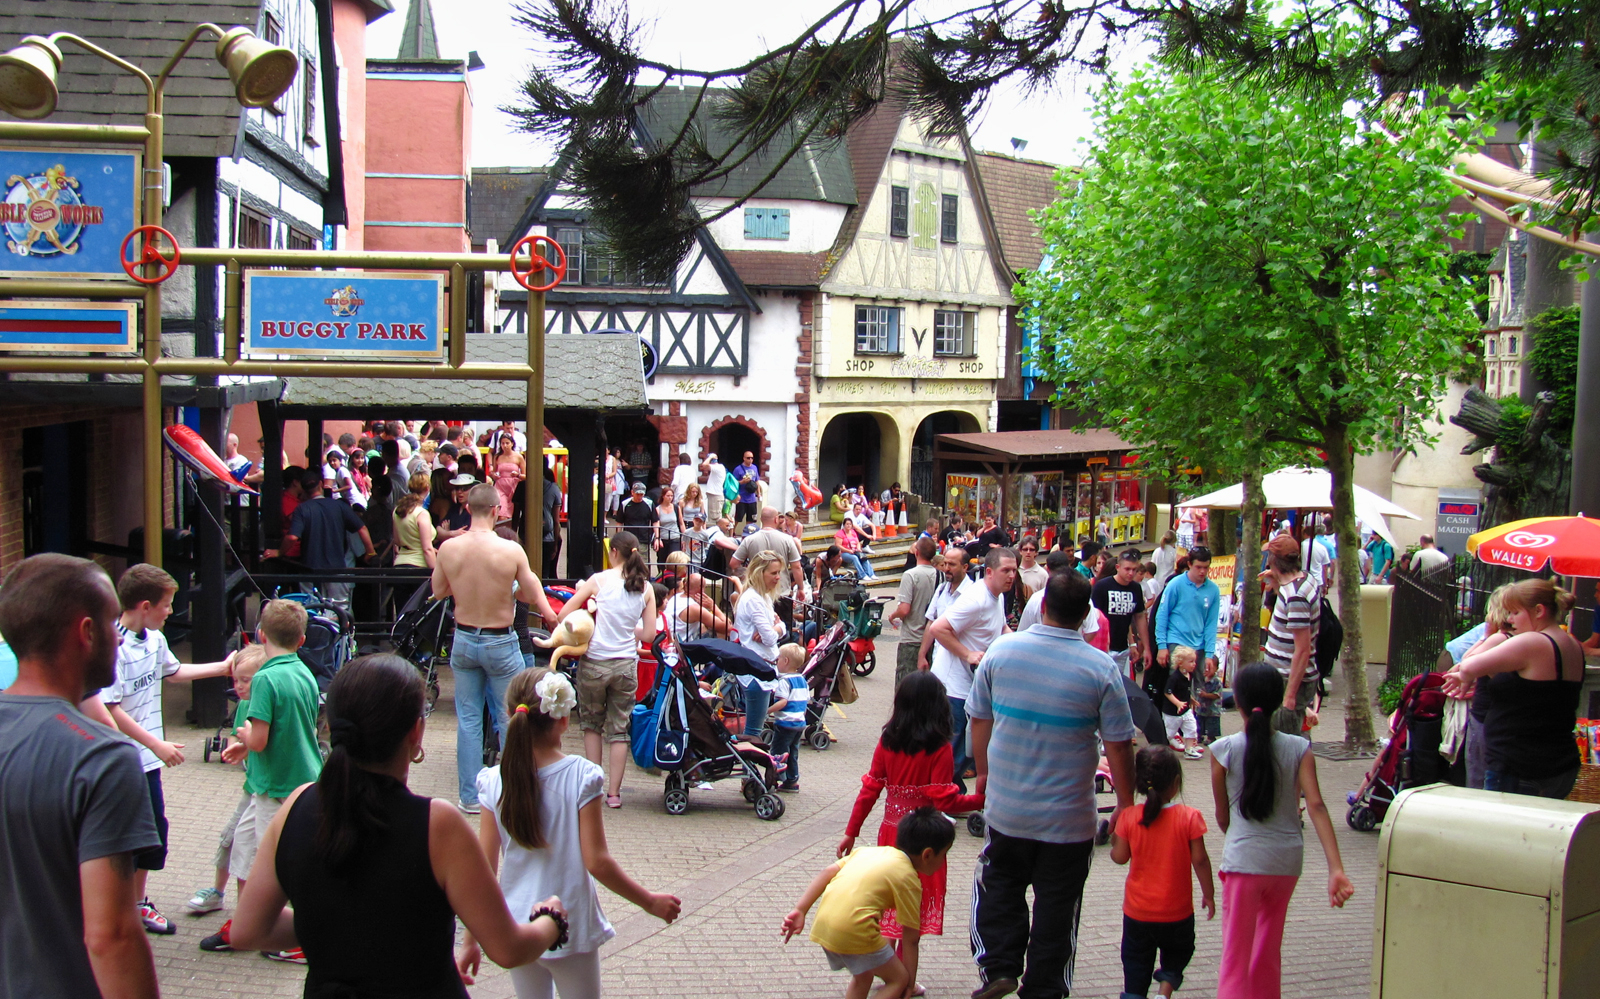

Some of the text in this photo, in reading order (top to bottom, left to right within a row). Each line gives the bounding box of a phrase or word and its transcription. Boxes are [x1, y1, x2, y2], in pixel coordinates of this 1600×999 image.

[0, 203, 26, 223] BLE
[61, 204, 103, 225] WORKS
[261, 321, 427, 340] BUGGY PARK
[846, 360, 874, 371] SHOP
[959, 362, 984, 373] SHOP
[674, 379, 716, 394] SWEETS
[1446, 516, 1469, 524] CASH
[1437, 526, 1477, 534] MACHINE
[1491, 549, 1534, 567] WALL'S
[1108, 590, 1134, 603] FRED
